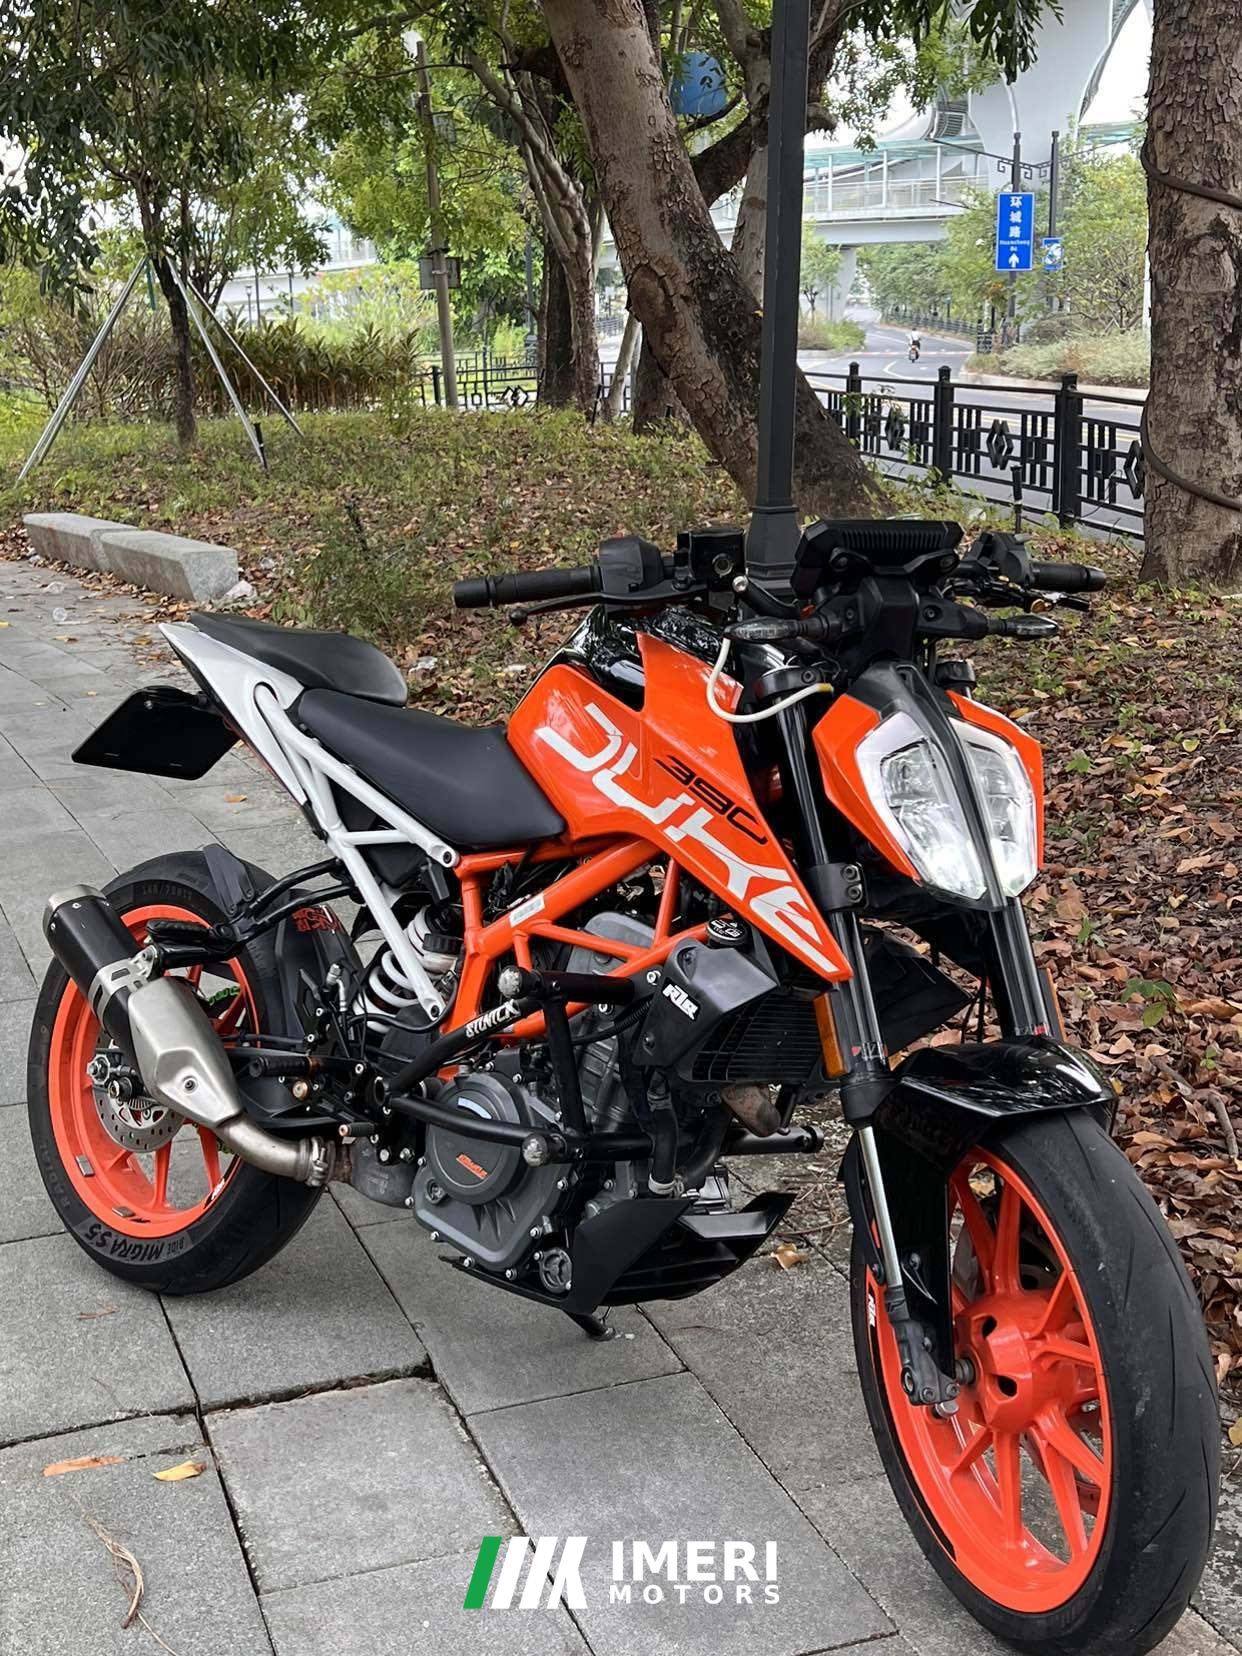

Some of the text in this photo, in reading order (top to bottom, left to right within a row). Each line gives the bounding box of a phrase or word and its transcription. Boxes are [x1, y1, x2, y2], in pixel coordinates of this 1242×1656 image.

[534, 703, 839, 973] DUKE
[653, 755, 767, 845] 390
[110, 1238, 165, 1261] MIGRA
